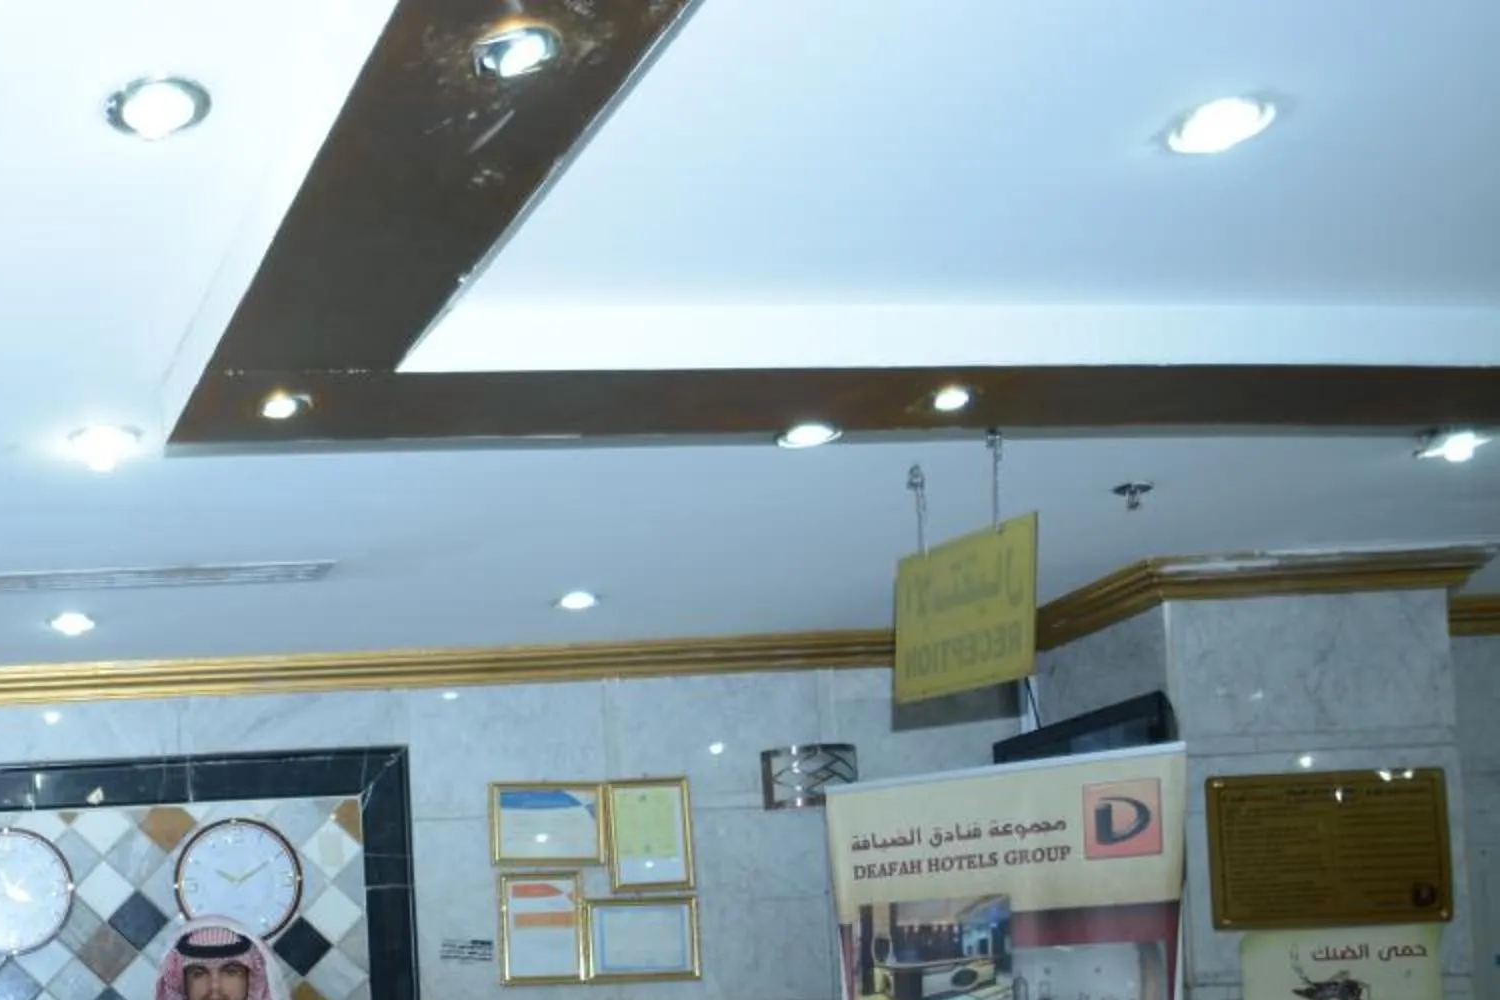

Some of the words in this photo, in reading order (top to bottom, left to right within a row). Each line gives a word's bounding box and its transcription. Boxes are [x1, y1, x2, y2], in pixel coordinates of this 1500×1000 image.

[850, 824, 923, 852] الضيافة
[928, 820, 983, 849] فنادق
[988, 816, 1068, 840] مجموعة
[852, 859, 923, 881] DEAFAH
[926, 852, 999, 874] HOTELS
[1003, 845, 1073, 865] GROUP
[1310, 943, 1371, 962] الضنك
